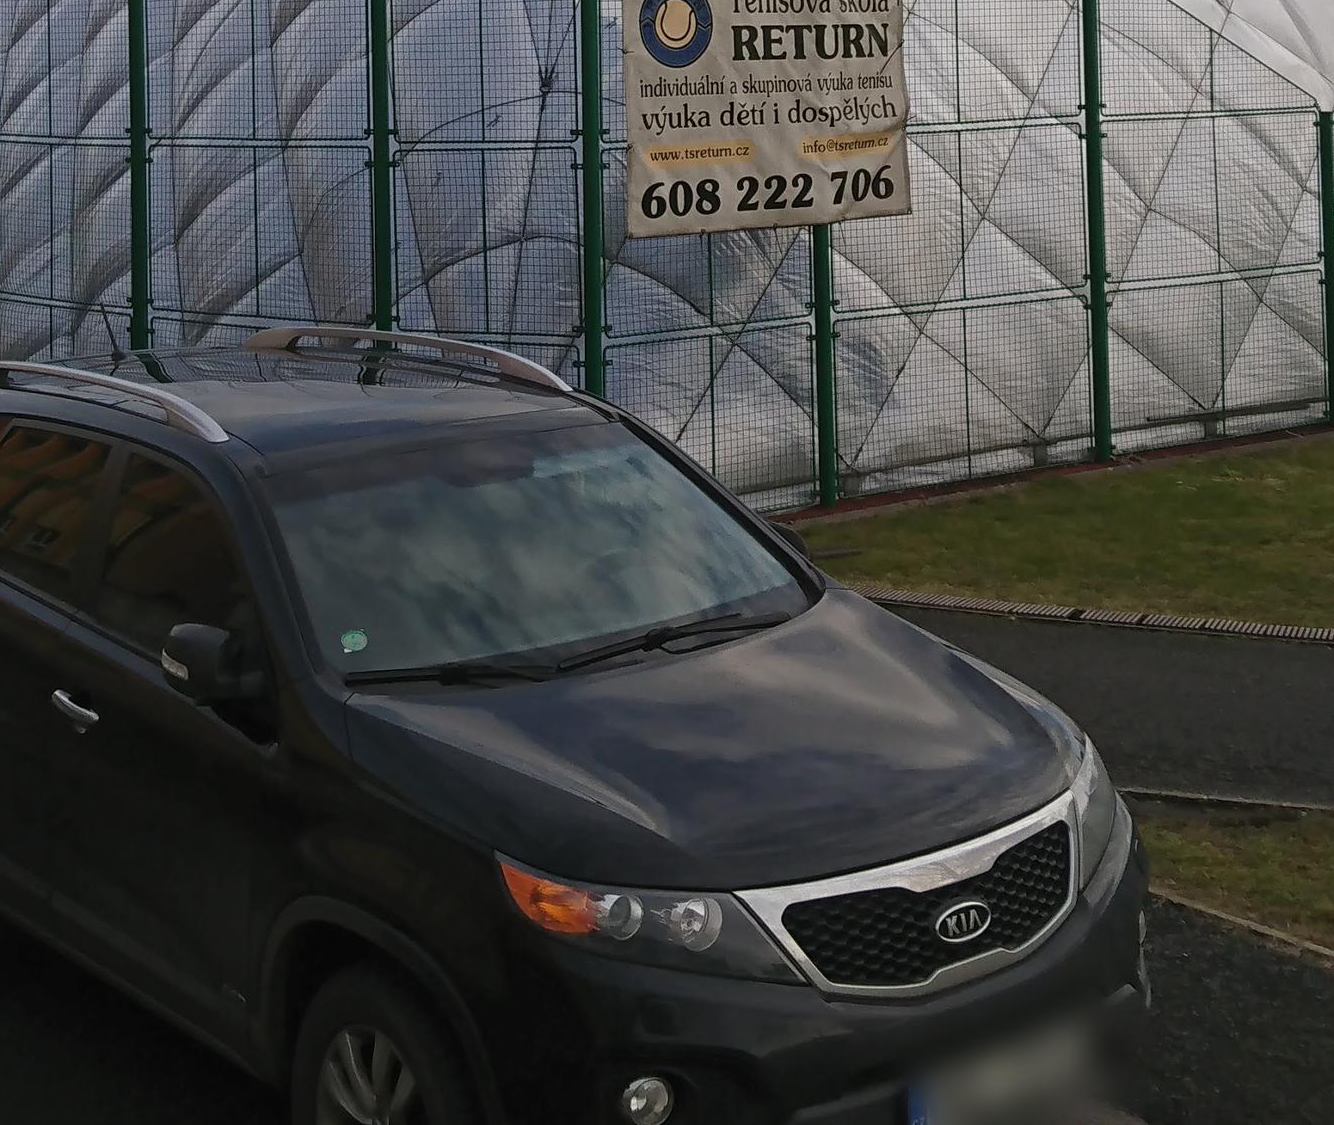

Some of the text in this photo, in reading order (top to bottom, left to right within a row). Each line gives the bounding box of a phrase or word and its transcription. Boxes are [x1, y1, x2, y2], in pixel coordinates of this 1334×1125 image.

[731, 23, 889, 61] RETURN
[639, 72, 893, 98] individuální a skupinová výuka tenisu
[642, 94, 898, 136] výuka dětí i dospělých
[650, 145, 750, 162] www.tsreturn.cz
[802, 136, 889, 154] info@tsreturn.cz
[641, 165, 894, 219] 608 222 706
[946, 908, 983, 937] KIA
